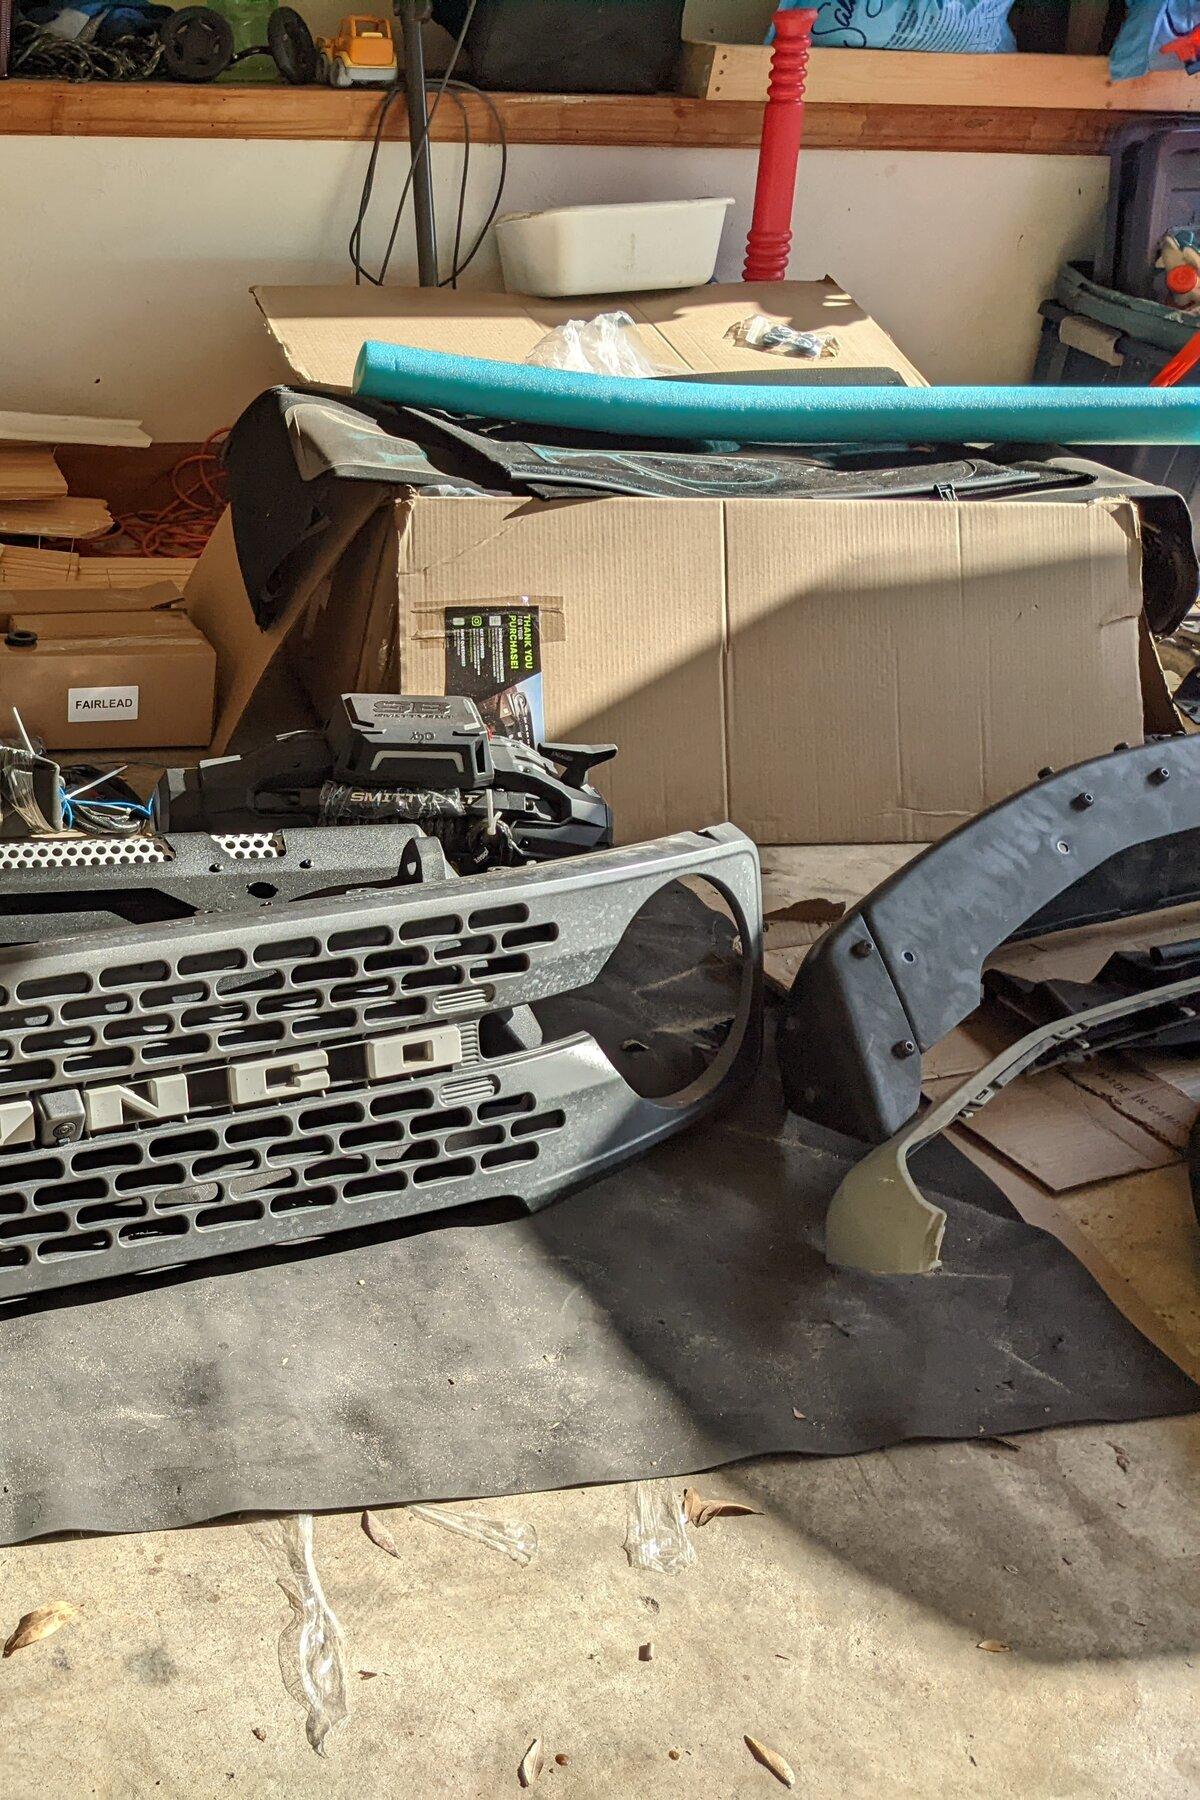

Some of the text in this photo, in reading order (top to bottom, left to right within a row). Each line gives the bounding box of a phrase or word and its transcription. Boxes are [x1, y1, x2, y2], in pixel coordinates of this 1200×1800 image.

[508, 614, 519, 669] PURCHASE!
[522, 614, 533, 669] THANK YOU
[75, 697, 134, 711] FAIRLEAD
[350, 791, 481, 805] SMITTYBLT
